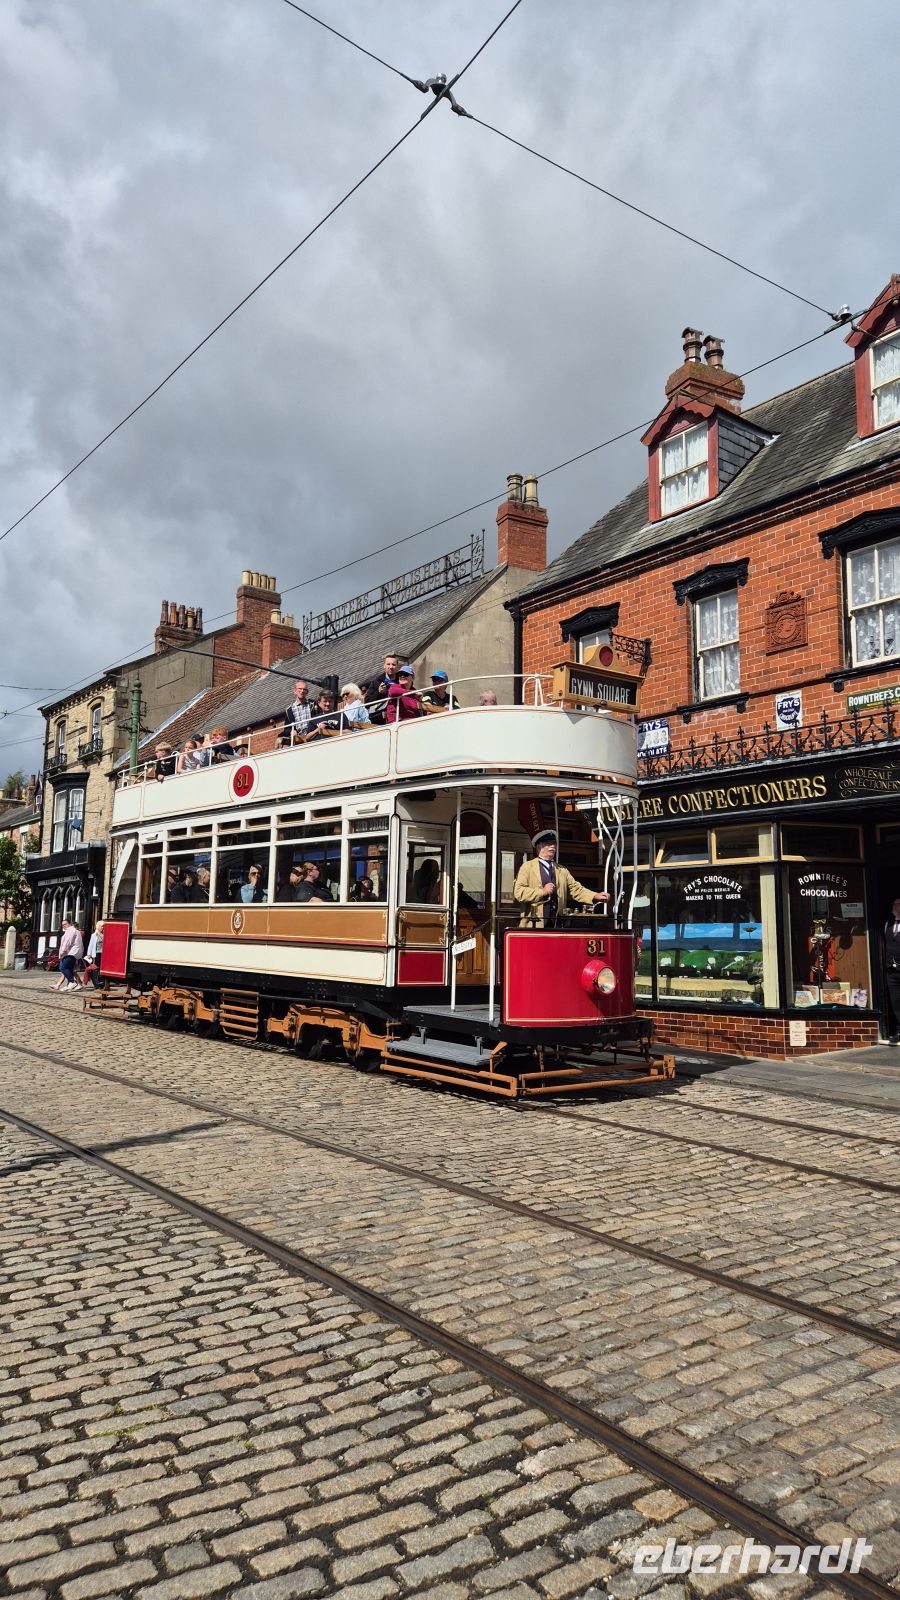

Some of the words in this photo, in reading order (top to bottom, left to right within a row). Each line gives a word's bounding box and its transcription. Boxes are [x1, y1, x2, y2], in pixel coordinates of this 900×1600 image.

[571, 677, 594, 699] GYNN
[597, 683, 631, 705] SQUARE
[237, 773, 249, 788] 31
[844, 768, 893, 780] WHOLESALE
[668, 775, 828, 815] CONFECTIONERS
[683, 878, 702, 894] FRY'S
[703, 875, 743, 893] CHOCOLATE
[797, 872, 848, 887] ROWNTREE'S
[800, 888, 848, 898] CHOCOLATES
[588, 939, 605, 954] 31
